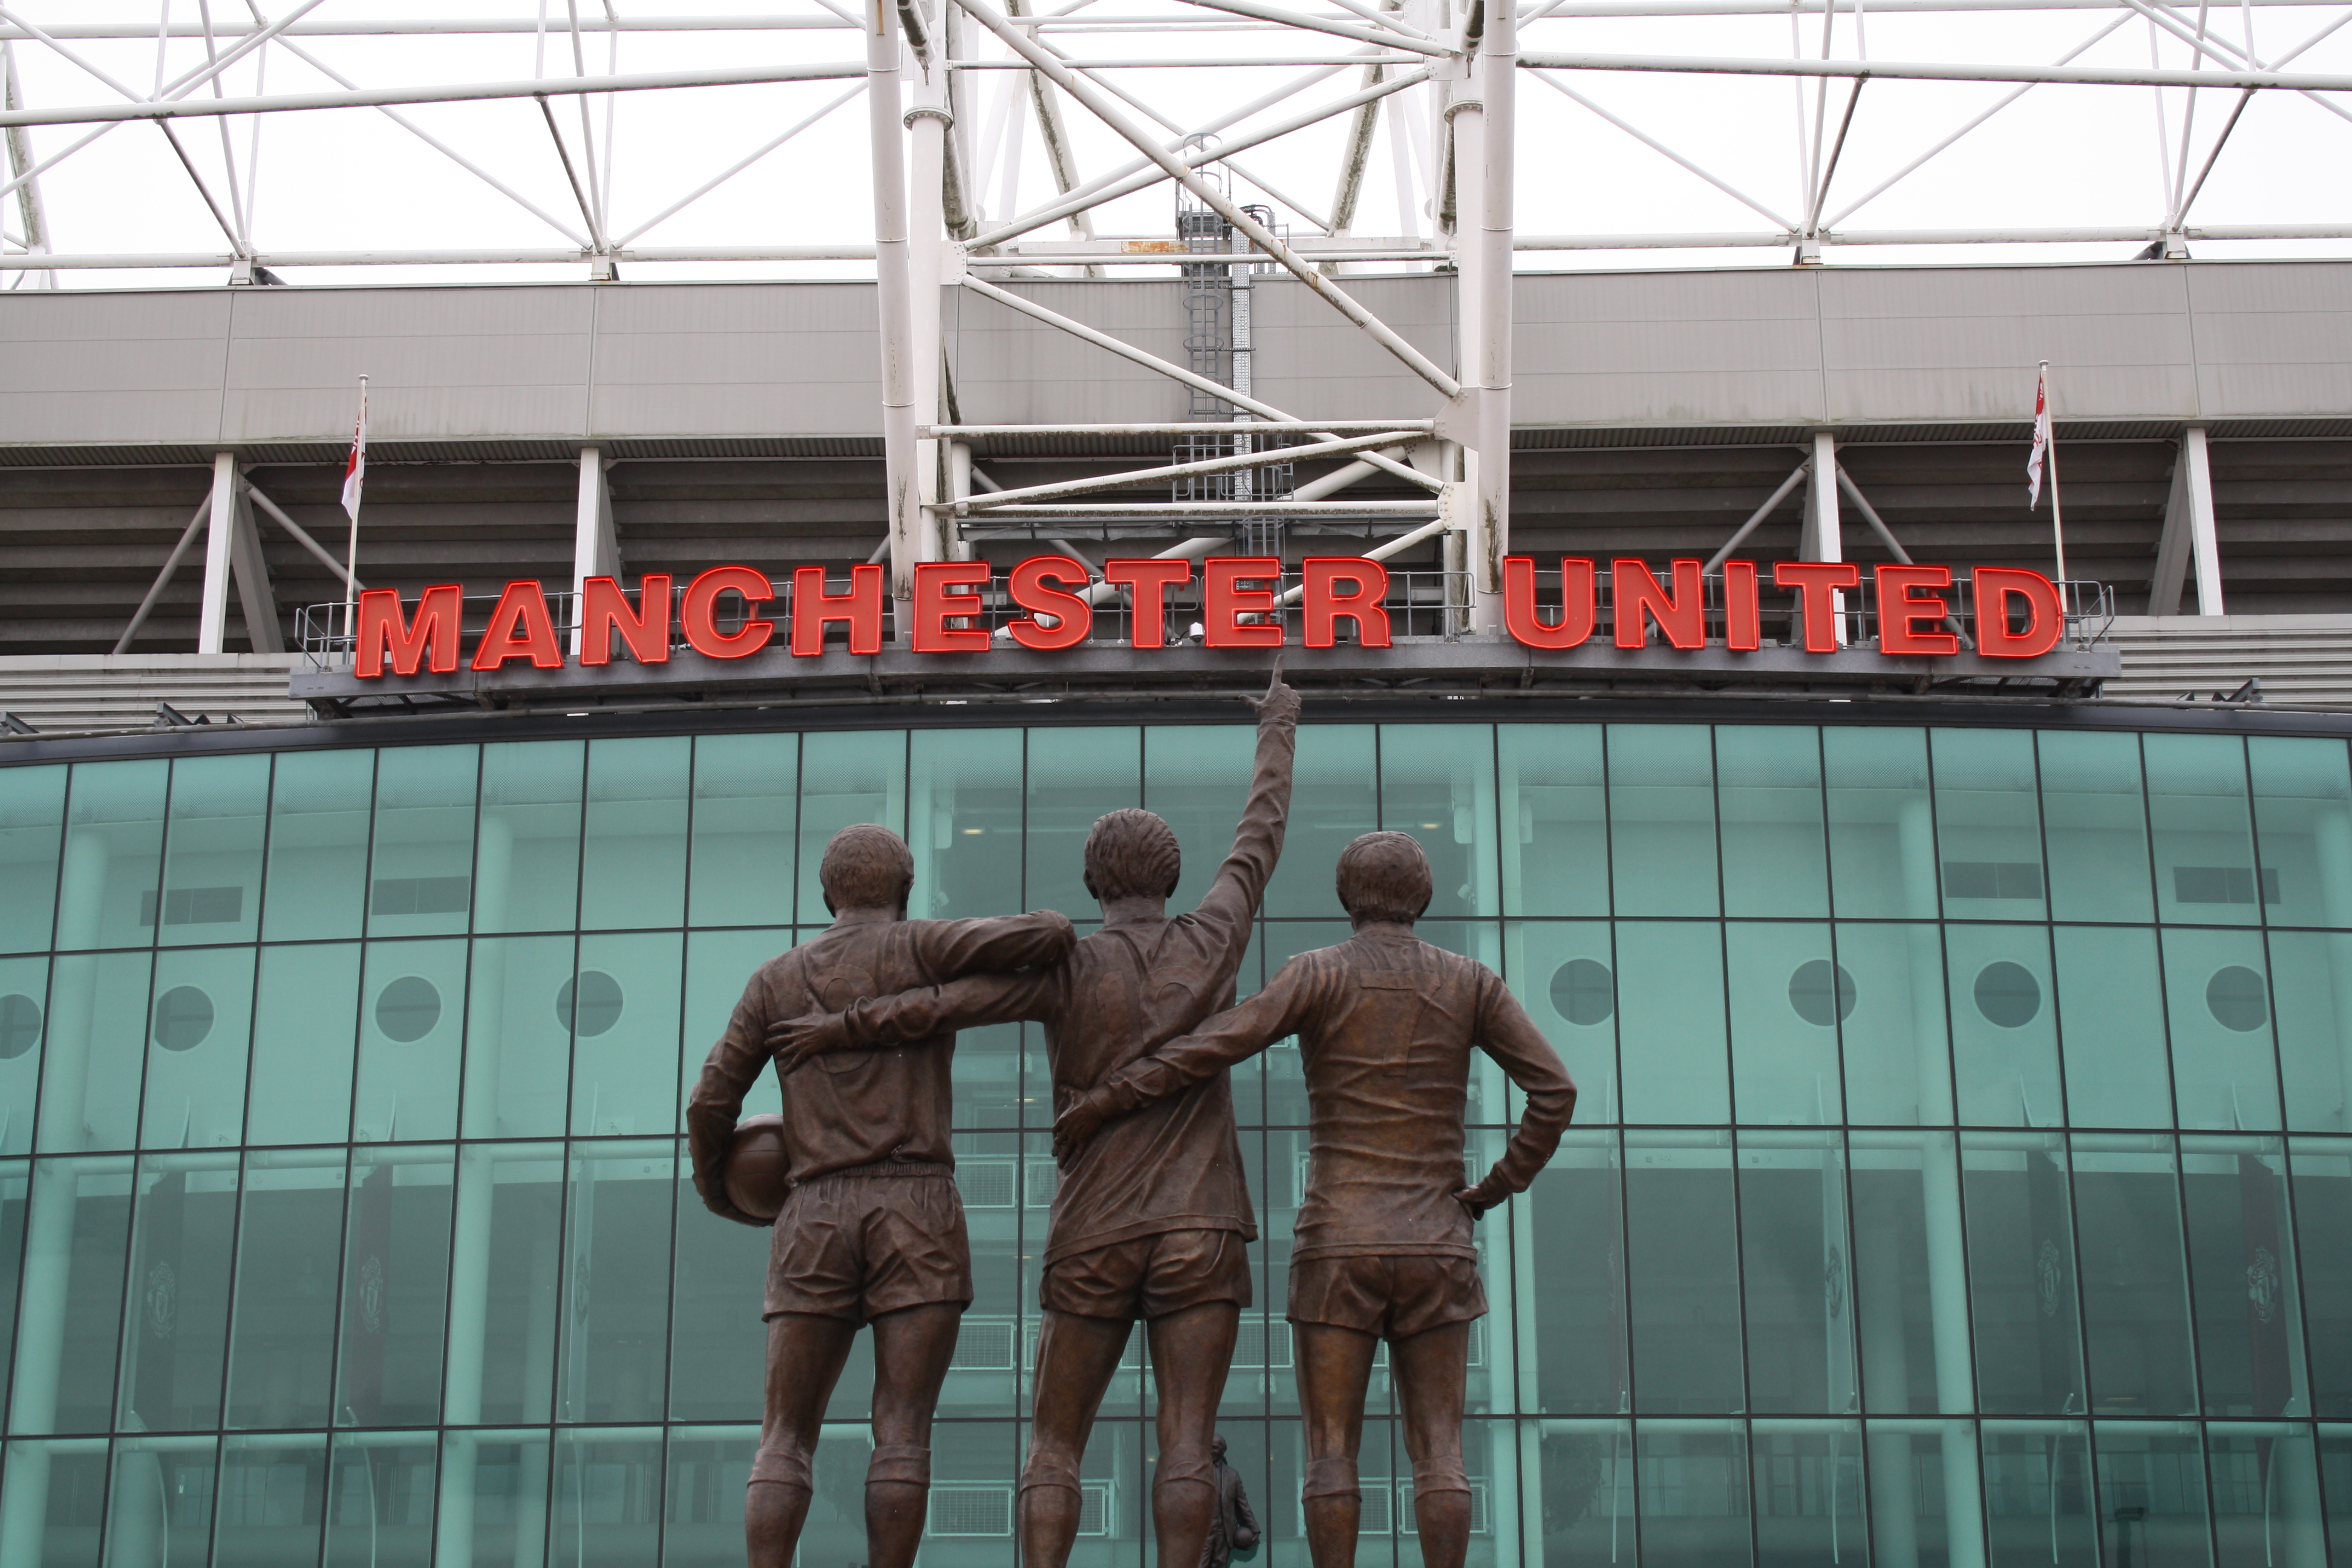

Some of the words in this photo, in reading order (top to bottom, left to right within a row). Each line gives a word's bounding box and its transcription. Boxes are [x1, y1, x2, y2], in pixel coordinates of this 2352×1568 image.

[353, 554, 1395, 680] MANCHESTER
[1501, 554, 2066, 659] UNITED
[1360, 969, 1441, 1076] 7
